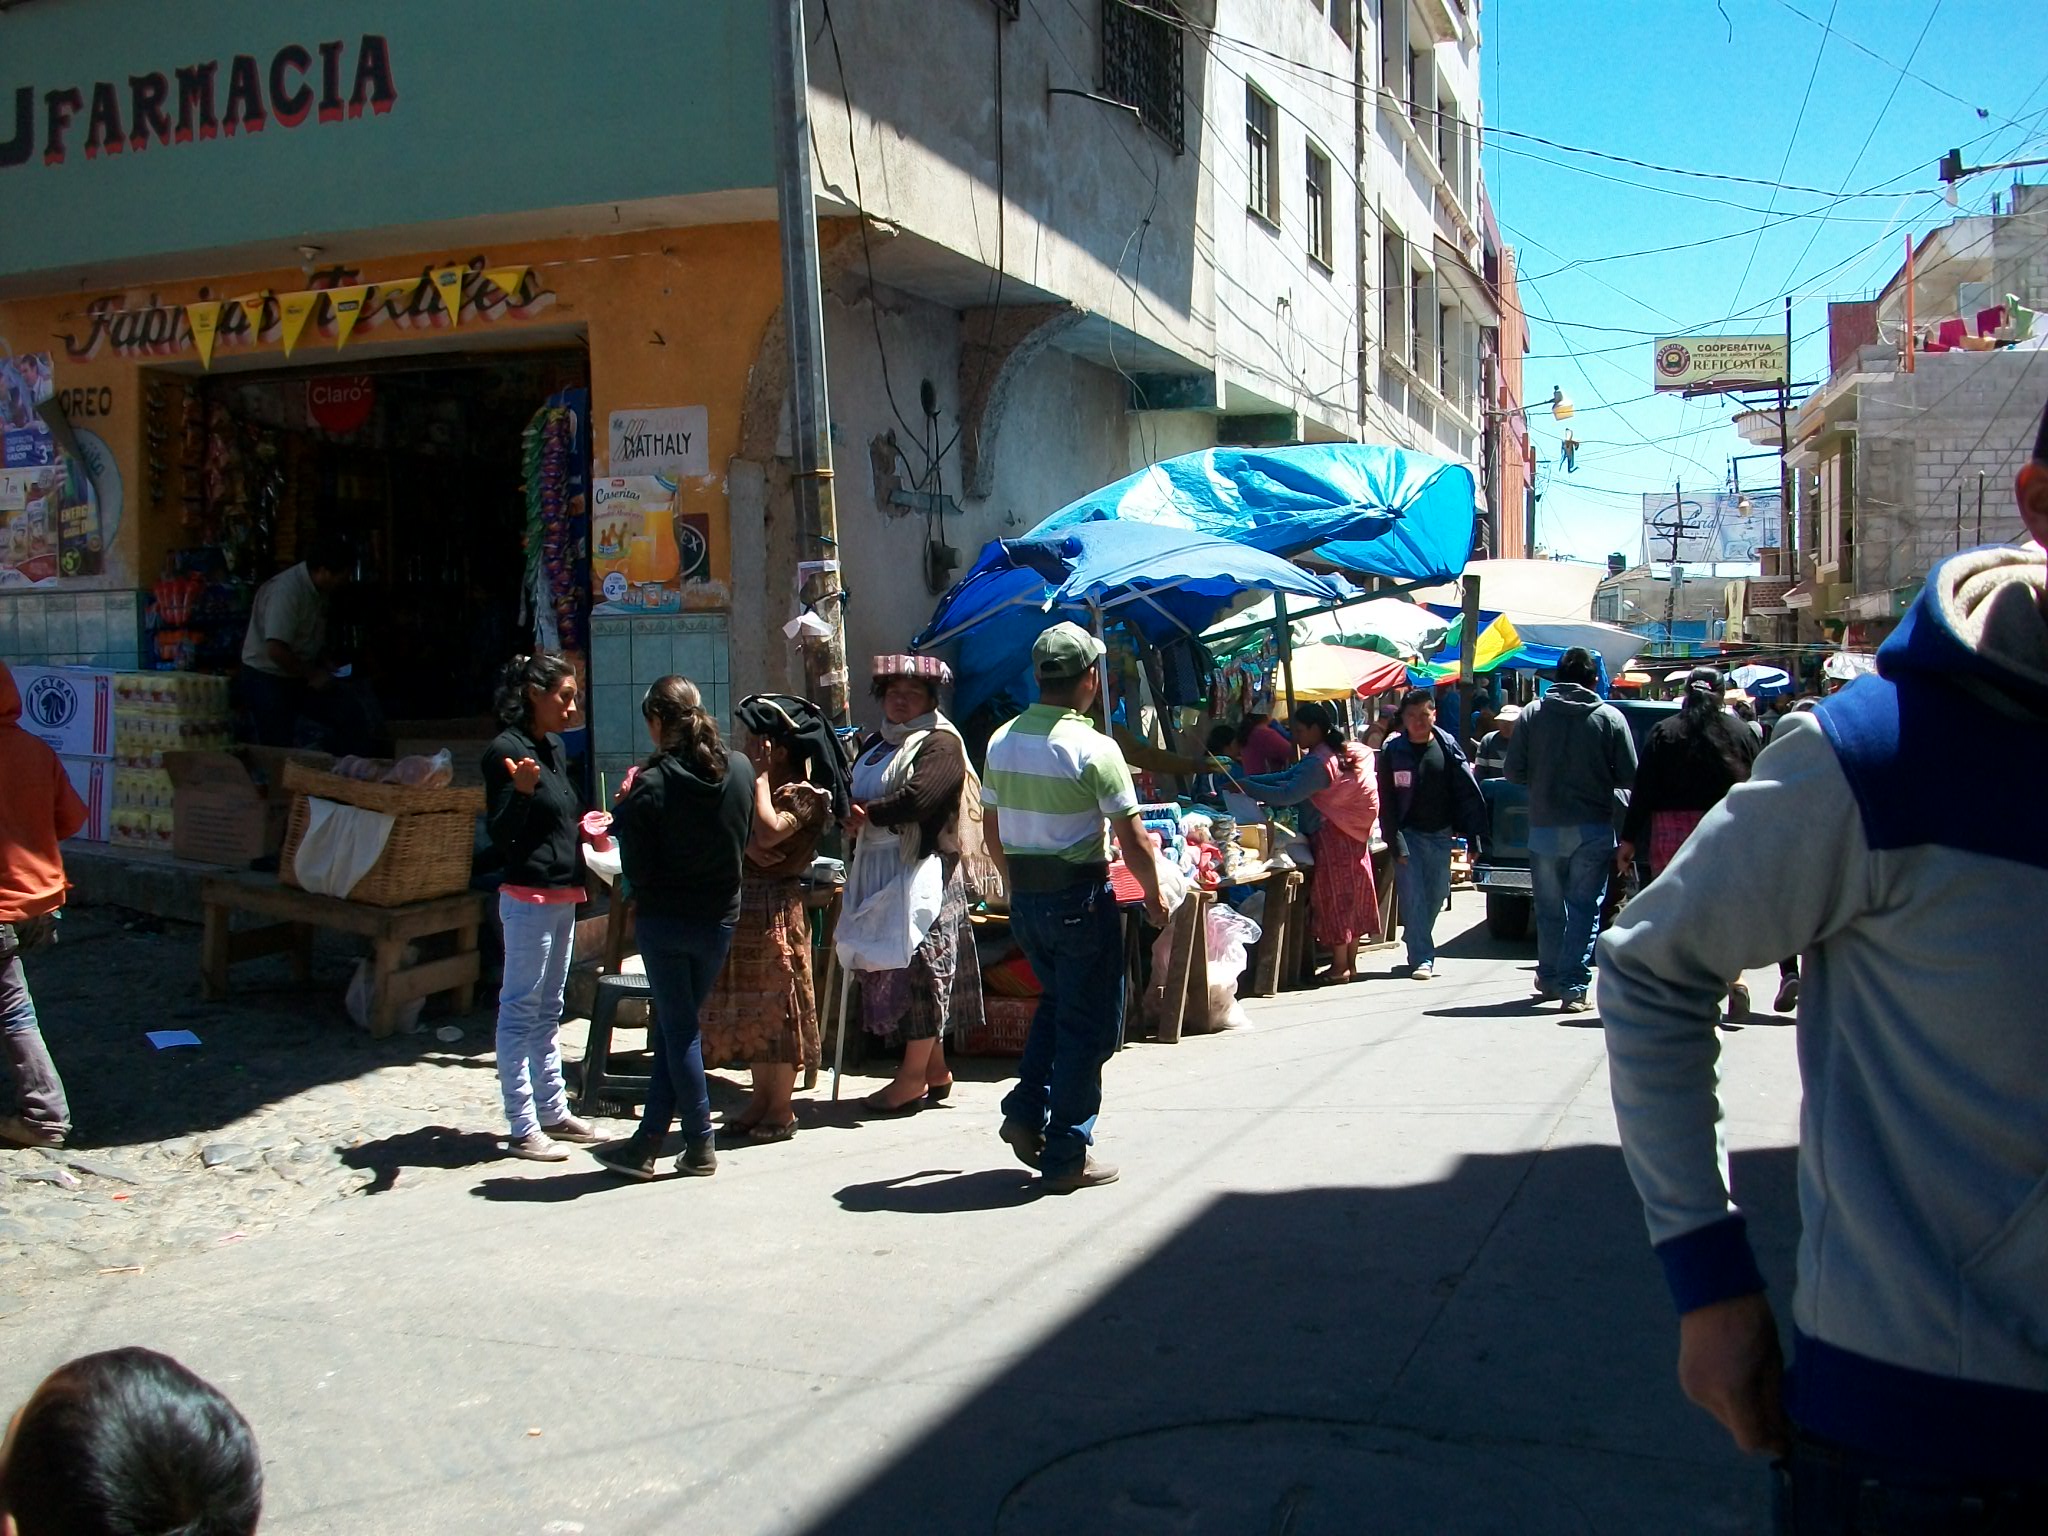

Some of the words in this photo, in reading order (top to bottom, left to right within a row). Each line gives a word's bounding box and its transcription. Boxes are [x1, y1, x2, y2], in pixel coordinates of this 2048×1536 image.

[43, 33, 398, 165] FARMACIA
[65, 286, 282, 357] Fabras
[1697, 343, 1771, 352] COOPERATIVA
[1693, 359, 1756, 371] REFICOM
[312, 385, 362, 405] Claro
[623, 432, 692, 460] NATHALY
[595, 488, 640, 504] Caseritas
[34, 677, 71, 699] REYMA
